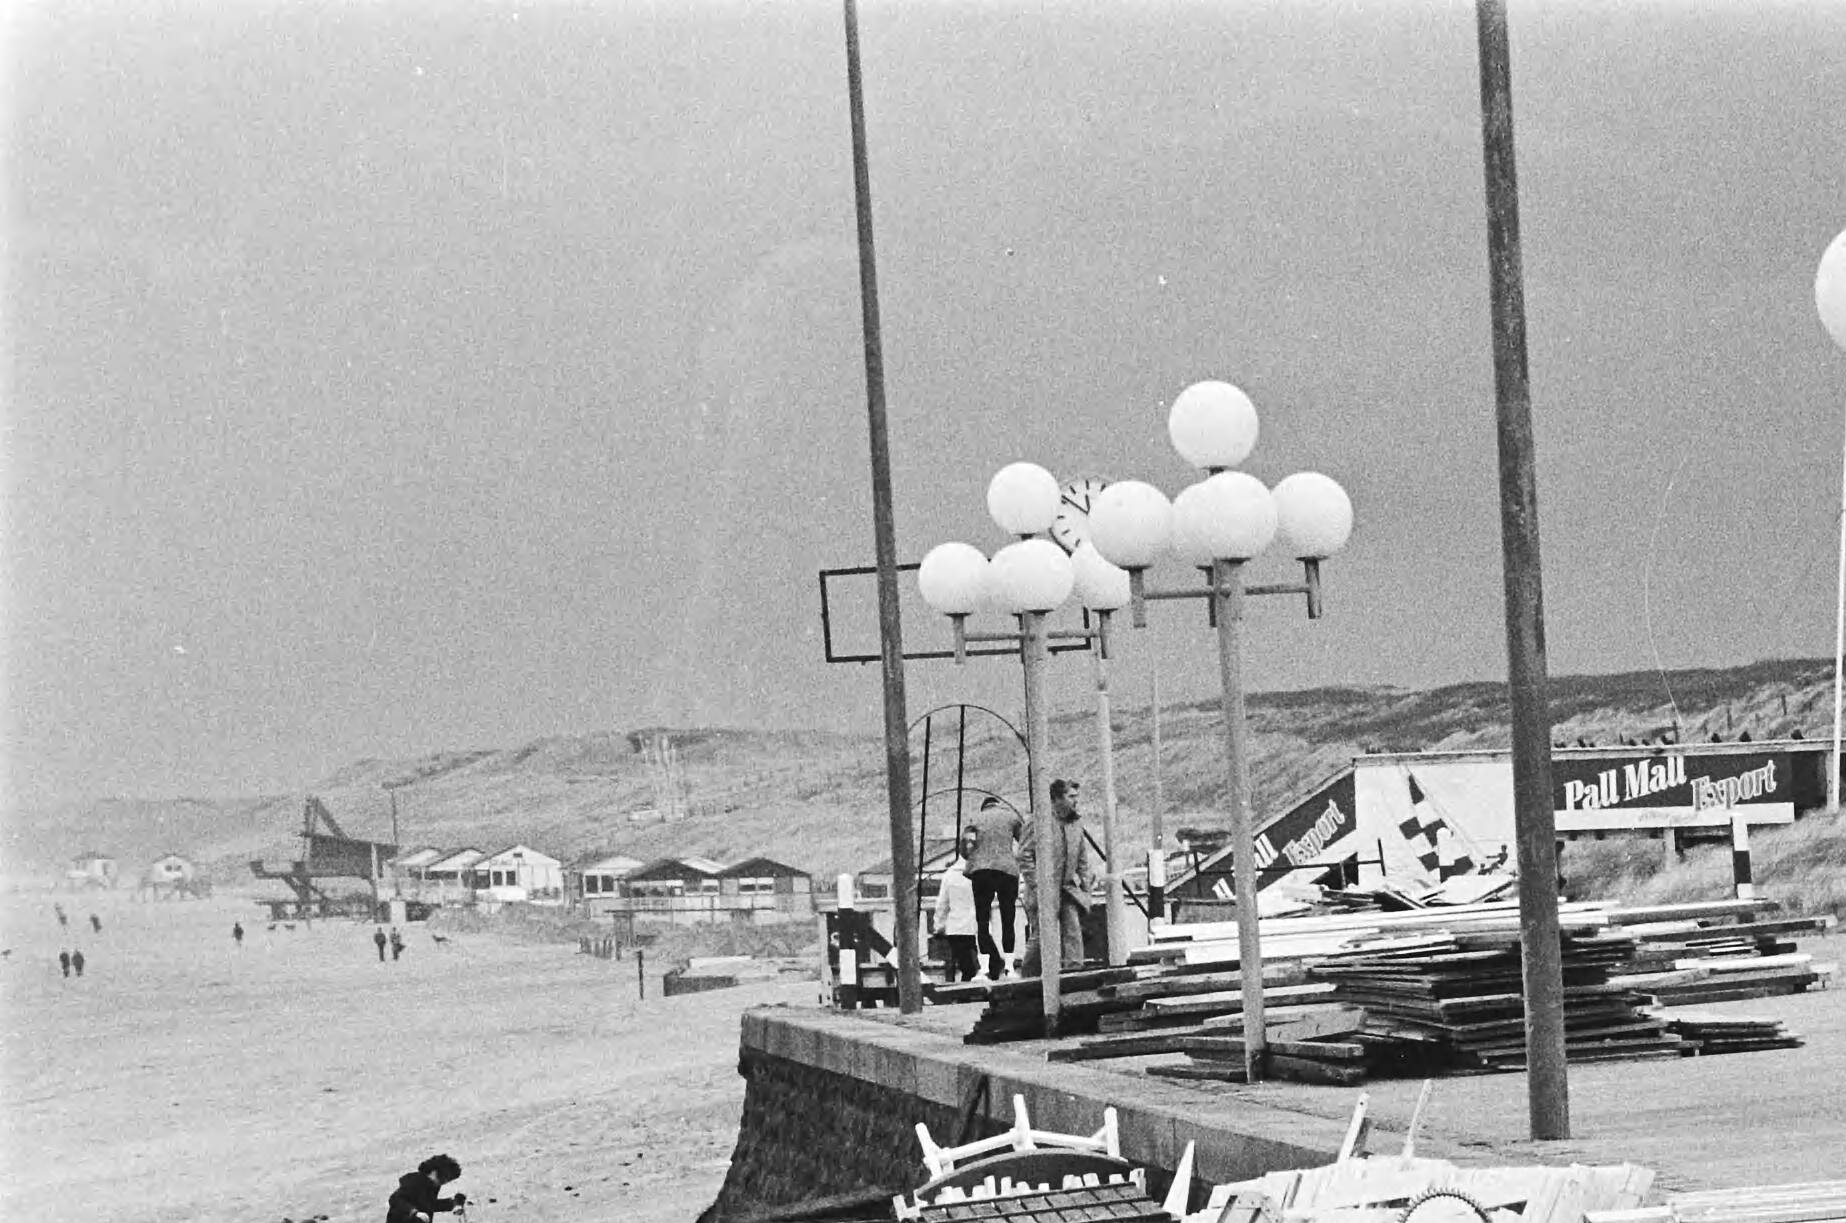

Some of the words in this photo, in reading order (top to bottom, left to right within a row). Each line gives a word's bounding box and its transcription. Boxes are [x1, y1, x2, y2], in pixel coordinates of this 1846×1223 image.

[1563, 769, 1620, 811] Pall
[1623, 755, 1688, 801] Mall
[1690, 759, 1777, 811] Export
[1282, 799, 1346, 866] Export
